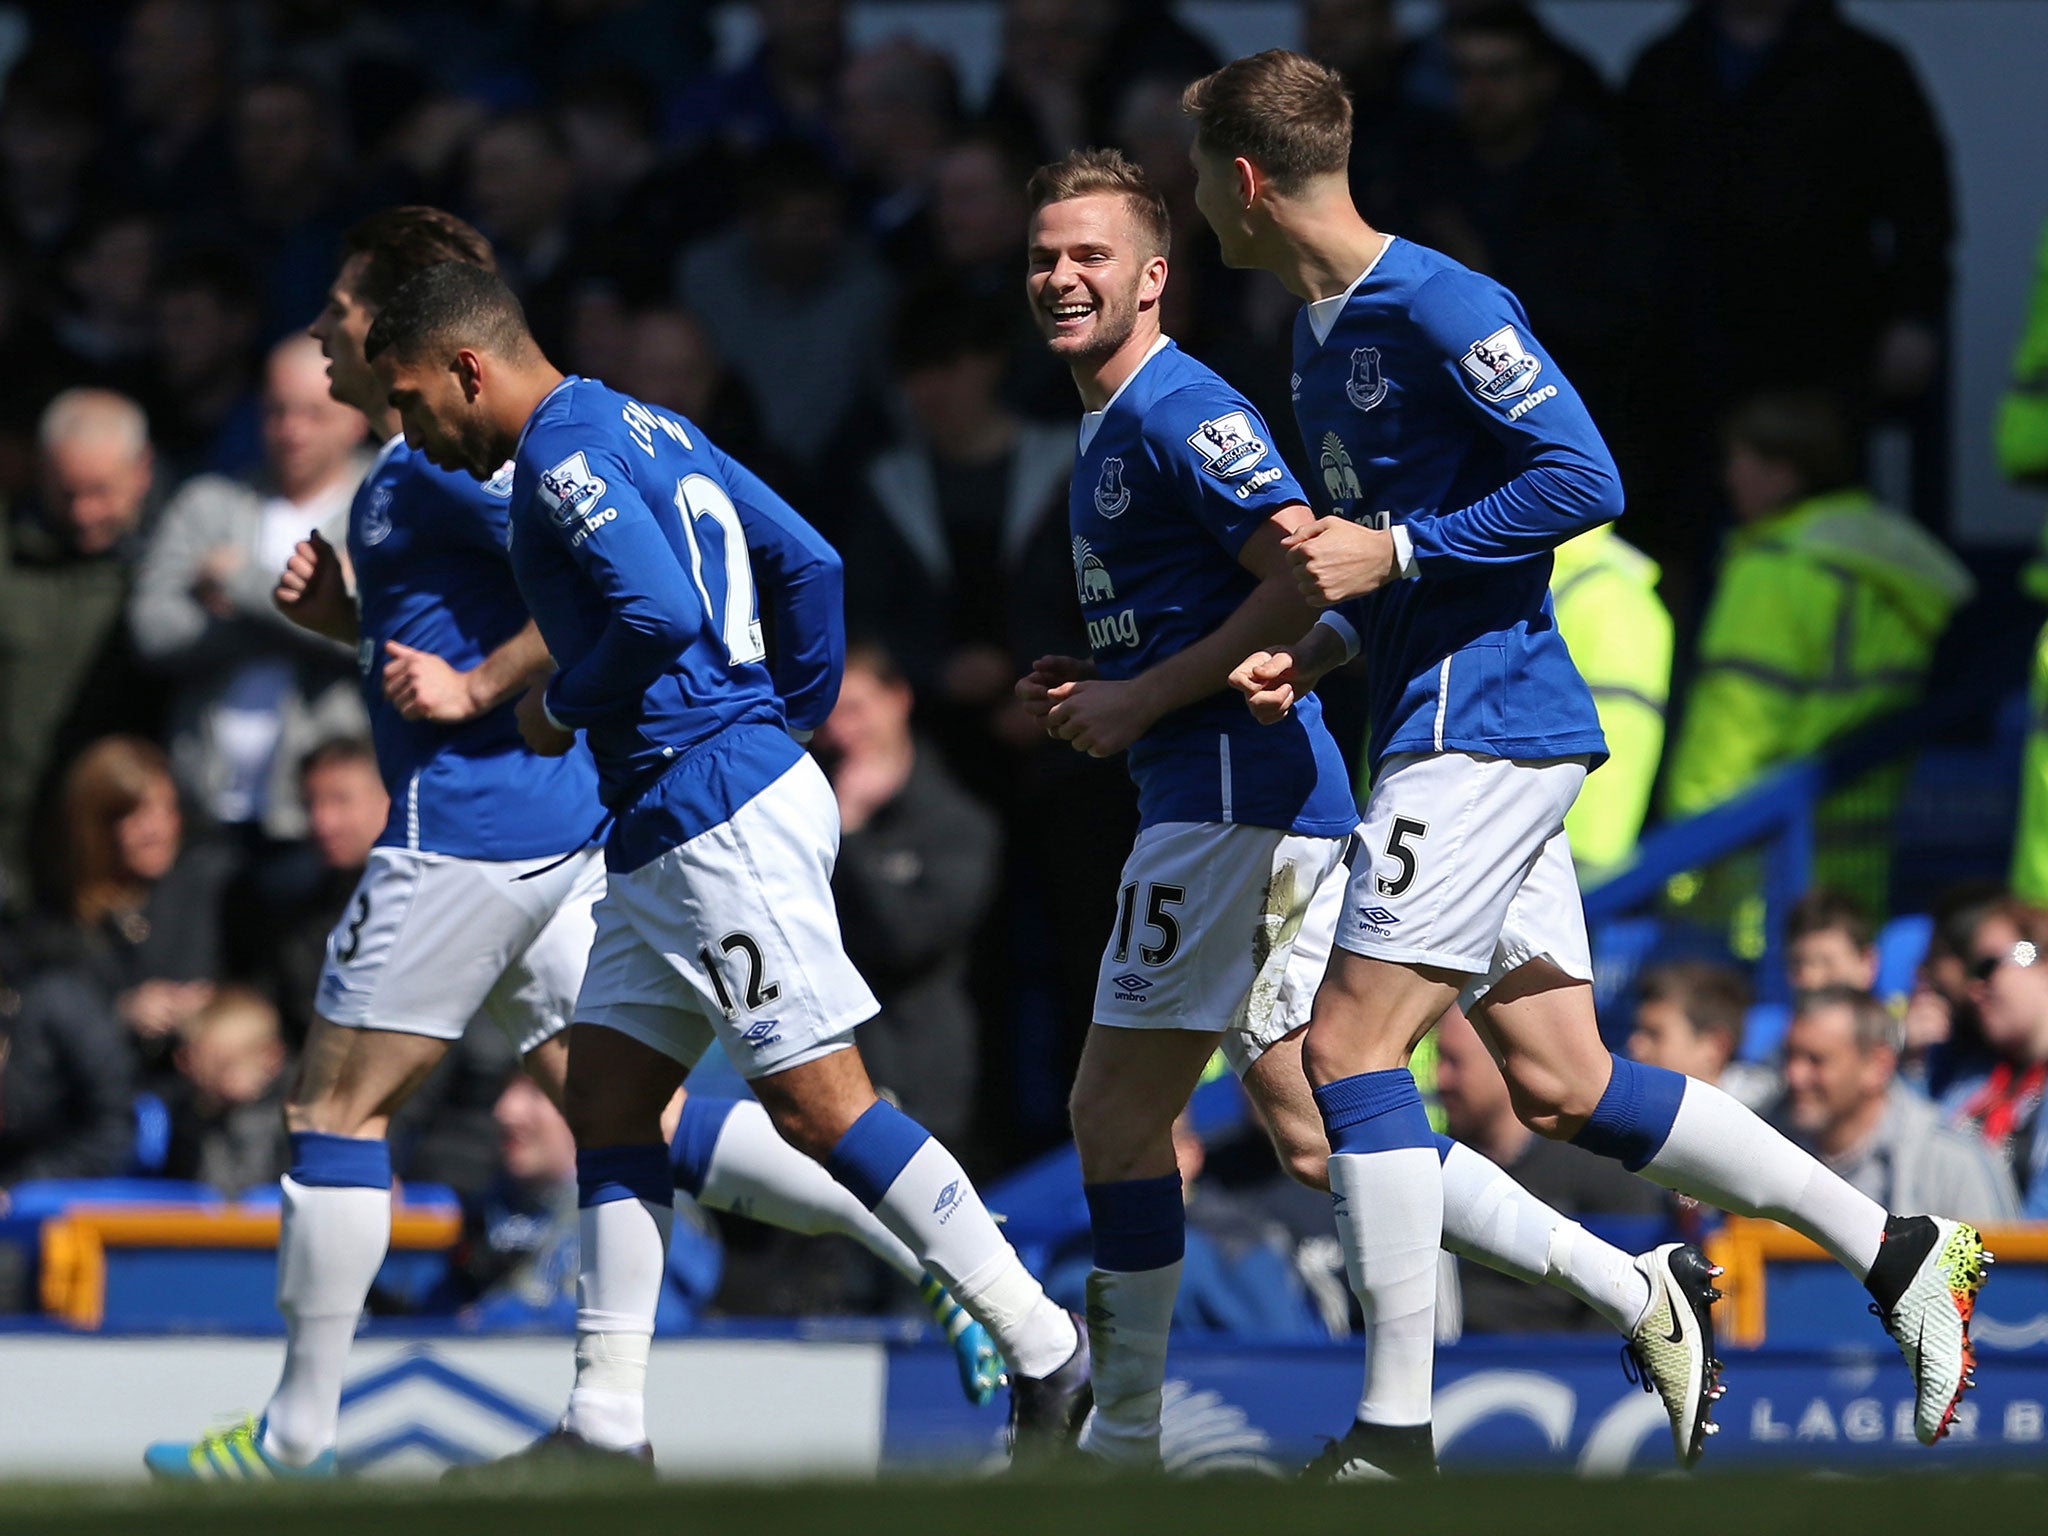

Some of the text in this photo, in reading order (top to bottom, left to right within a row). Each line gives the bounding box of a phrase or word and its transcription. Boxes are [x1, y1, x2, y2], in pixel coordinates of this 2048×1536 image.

[1505, 384, 1559, 423] umbro
[1215, 442, 1254, 469] BARCLAYS
[1235, 467, 1283, 499] umbro
[571, 507, 619, 547] umbro
[1374, 814, 1430, 899] 5
[336, 892, 370, 965] 3
[1112, 881, 1185, 967] 15
[1358, 921, 1392, 937] umbro
[697, 929, 783, 1021] 12
[1114, 991, 1147, 1003] umbro
[939, 1189, 968, 1226] umbro
